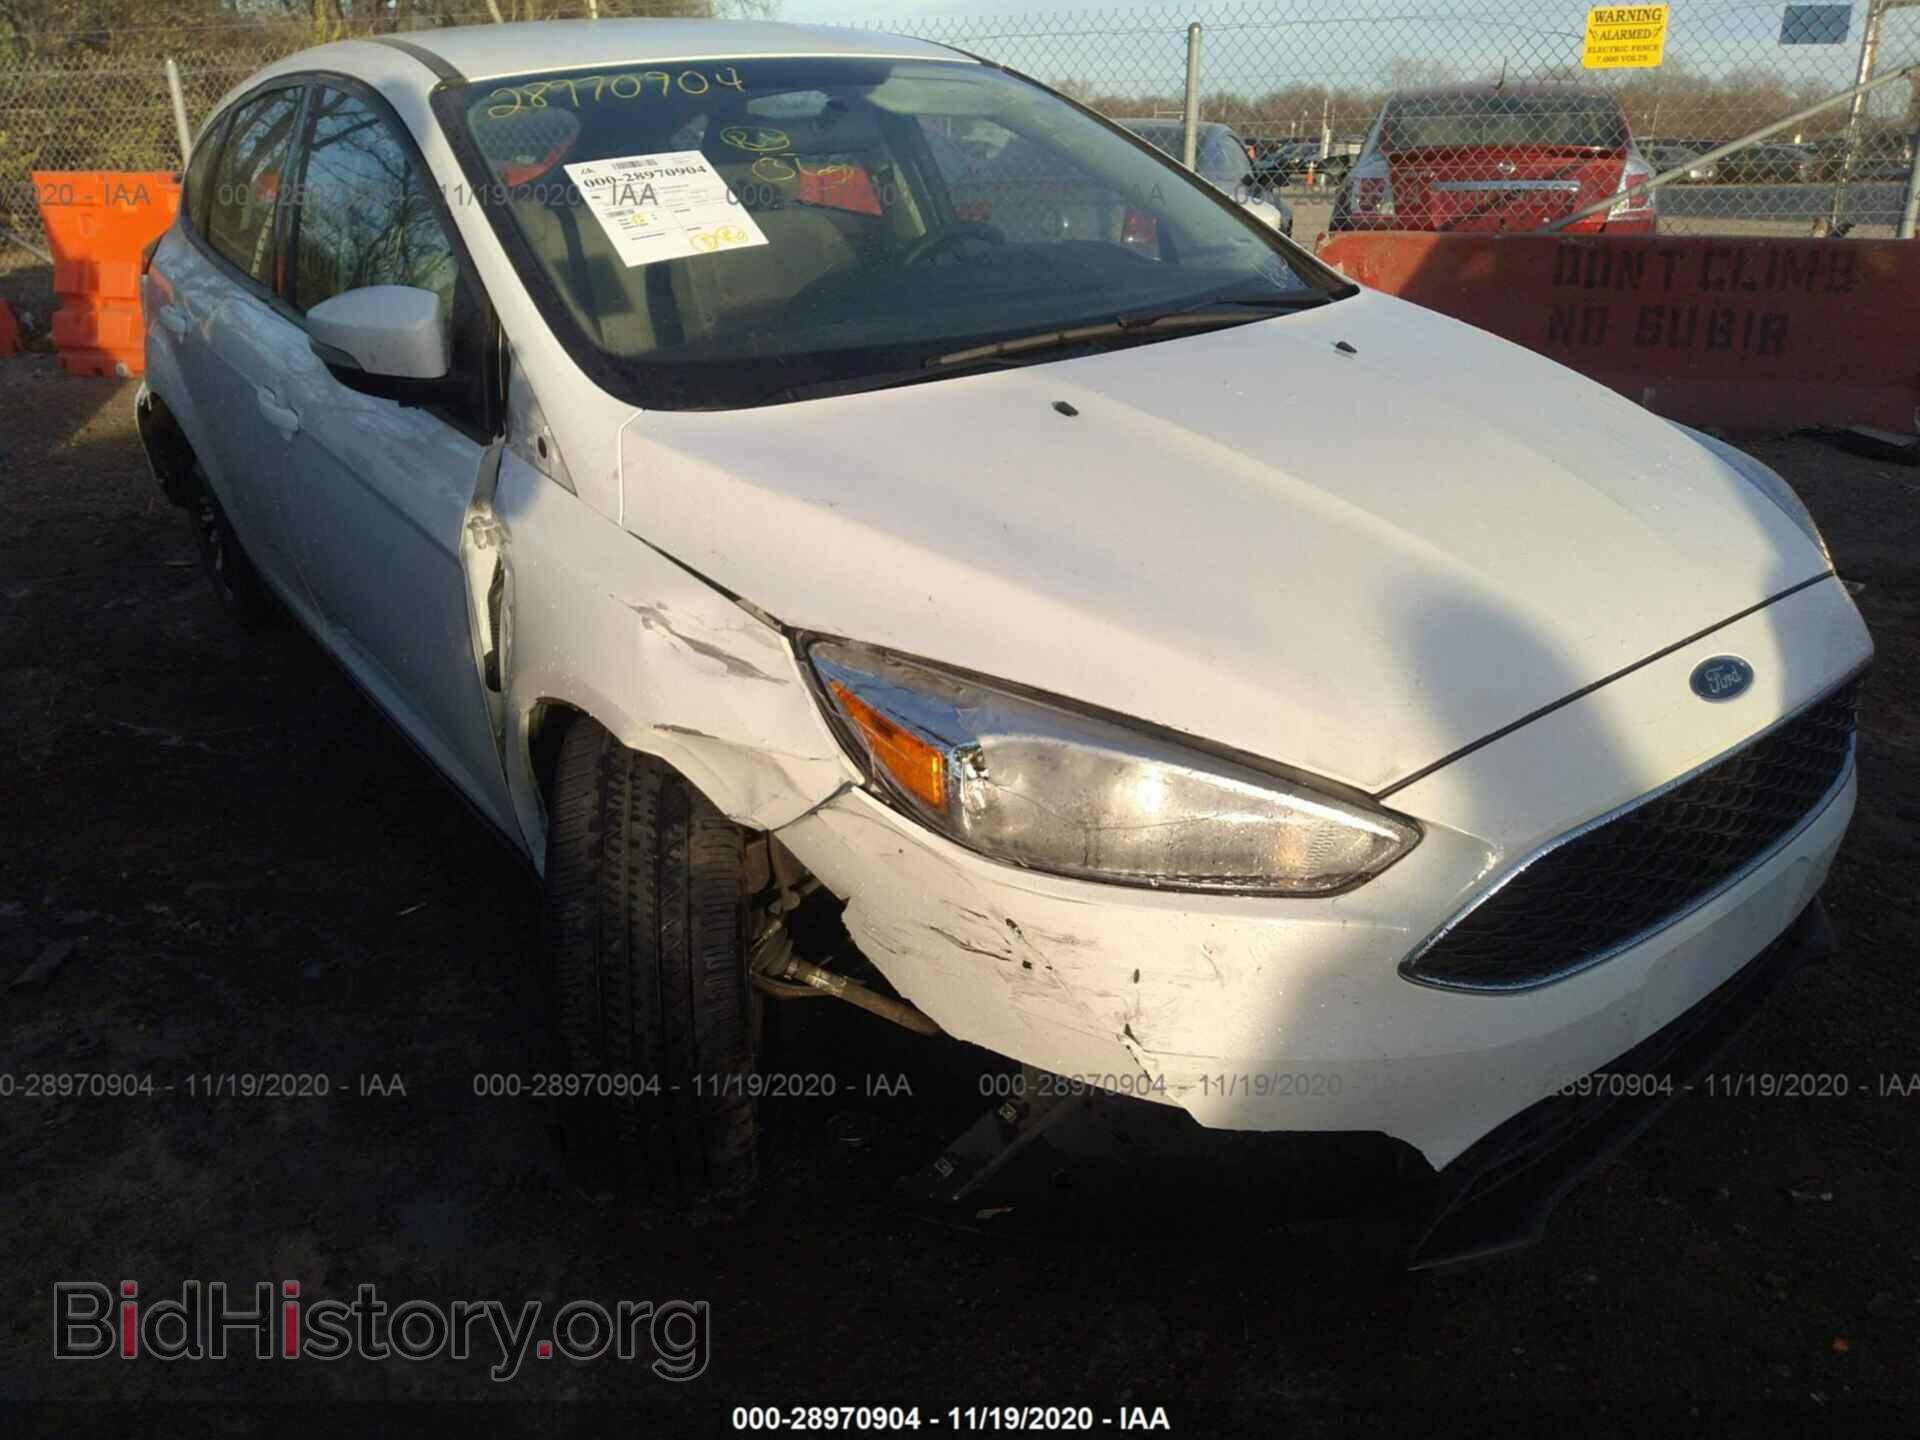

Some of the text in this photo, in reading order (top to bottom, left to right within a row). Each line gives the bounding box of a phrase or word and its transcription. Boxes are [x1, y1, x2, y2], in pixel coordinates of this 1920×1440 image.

[1594, 8, 1662, 23] WARNING
[1600, 29, 1652, 41] ALARMED
[1587, 44, 1659, 53] ELECTRIC FENCE
[1621, 54, 1648, 62] VOLTS
[487, 66, 744, 119] 28970904
[583, 165, 707, 189] 000-28970904
[1552, 243, 1859, 295] DONT CLIMB
[1544, 302, 1790, 356] NO SUBIR
[1704, 664, 1742, 693] Ford
